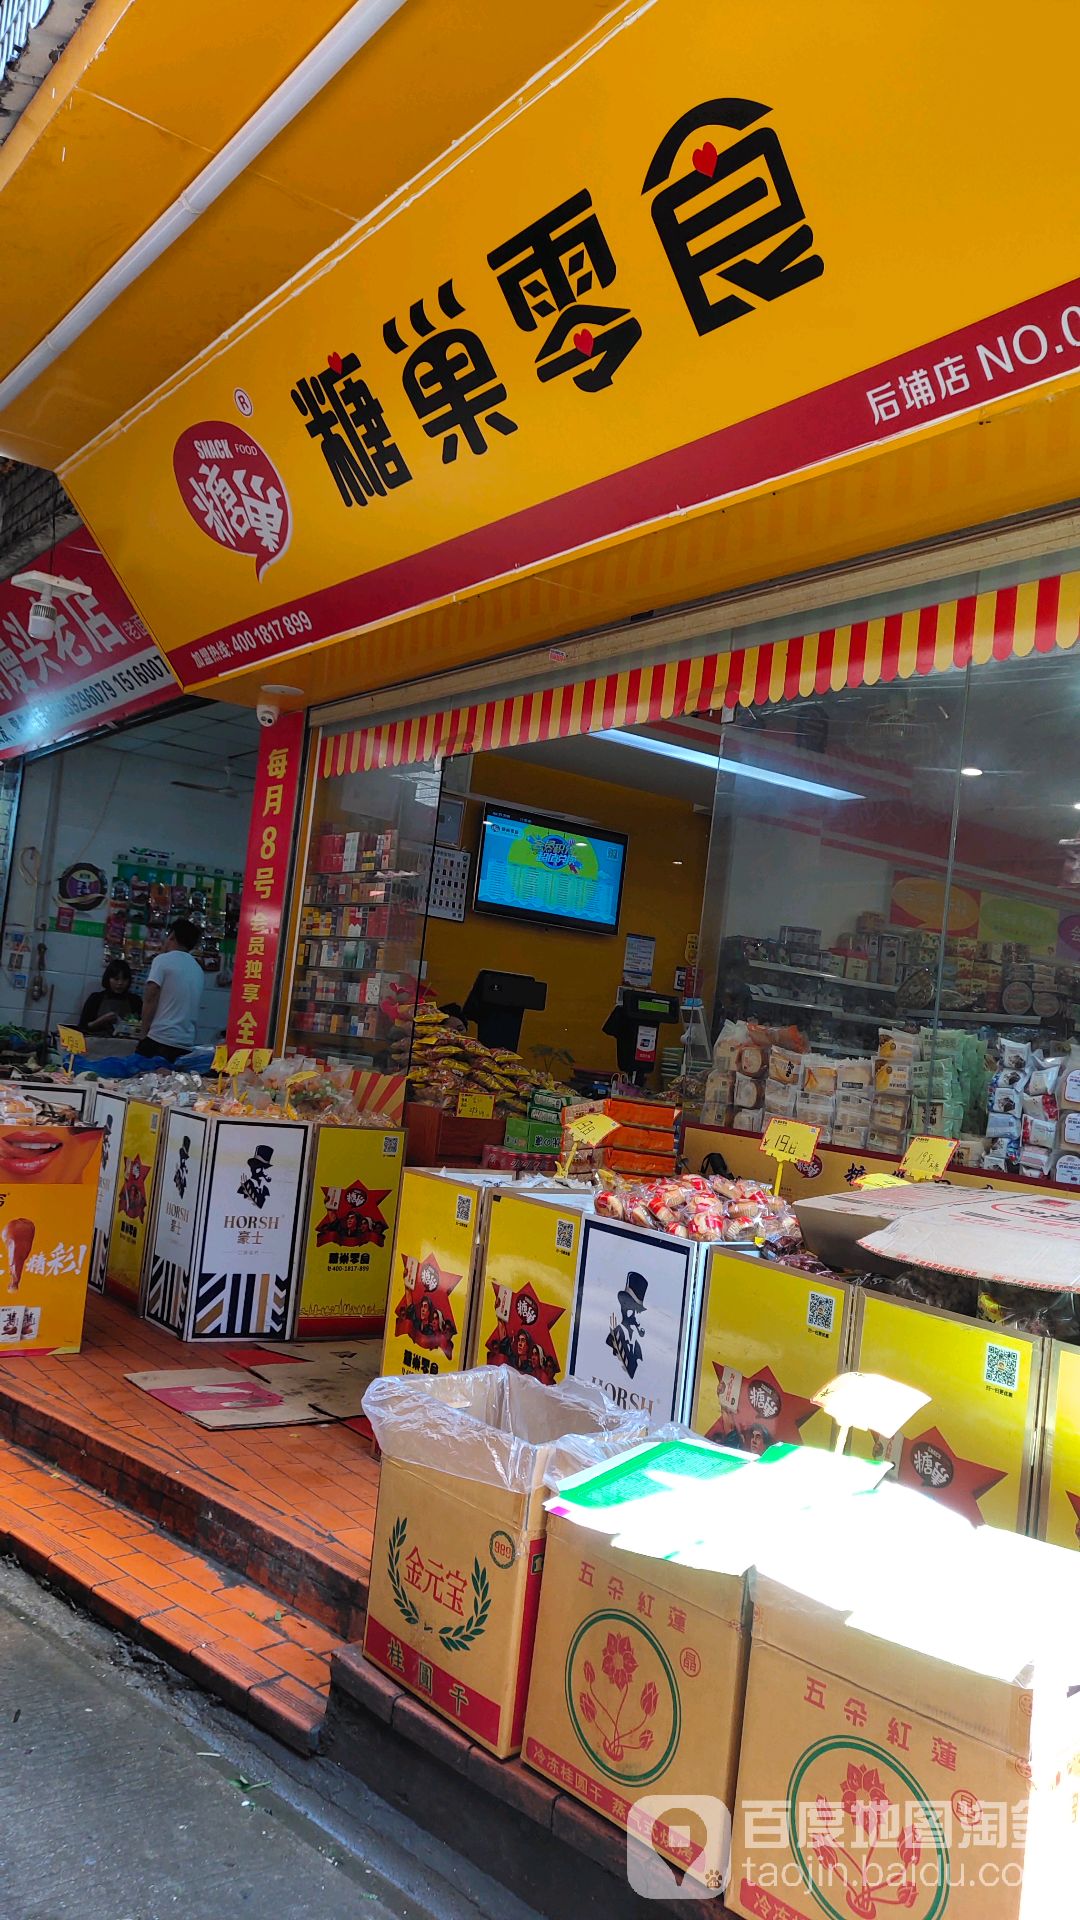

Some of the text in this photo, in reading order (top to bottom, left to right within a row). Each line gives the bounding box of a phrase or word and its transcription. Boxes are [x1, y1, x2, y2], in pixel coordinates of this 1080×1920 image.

[290, 97, 825, 508] 糖巢零食
[865, 355, 970, 426] 后埔店
[193, 439, 258, 459] SNACK FOOD
[187, 463, 284, 553] 糖巢
[231, 630, 257, 654] 400
[254, 619, 285, 646] 1817
[282, 610, 313, 636] 899
[223, 1215, 280, 1230] HORSH
[237, 1231, 265, 1245] 豪士
[404, 1545, 468, 1617] 金元宝
